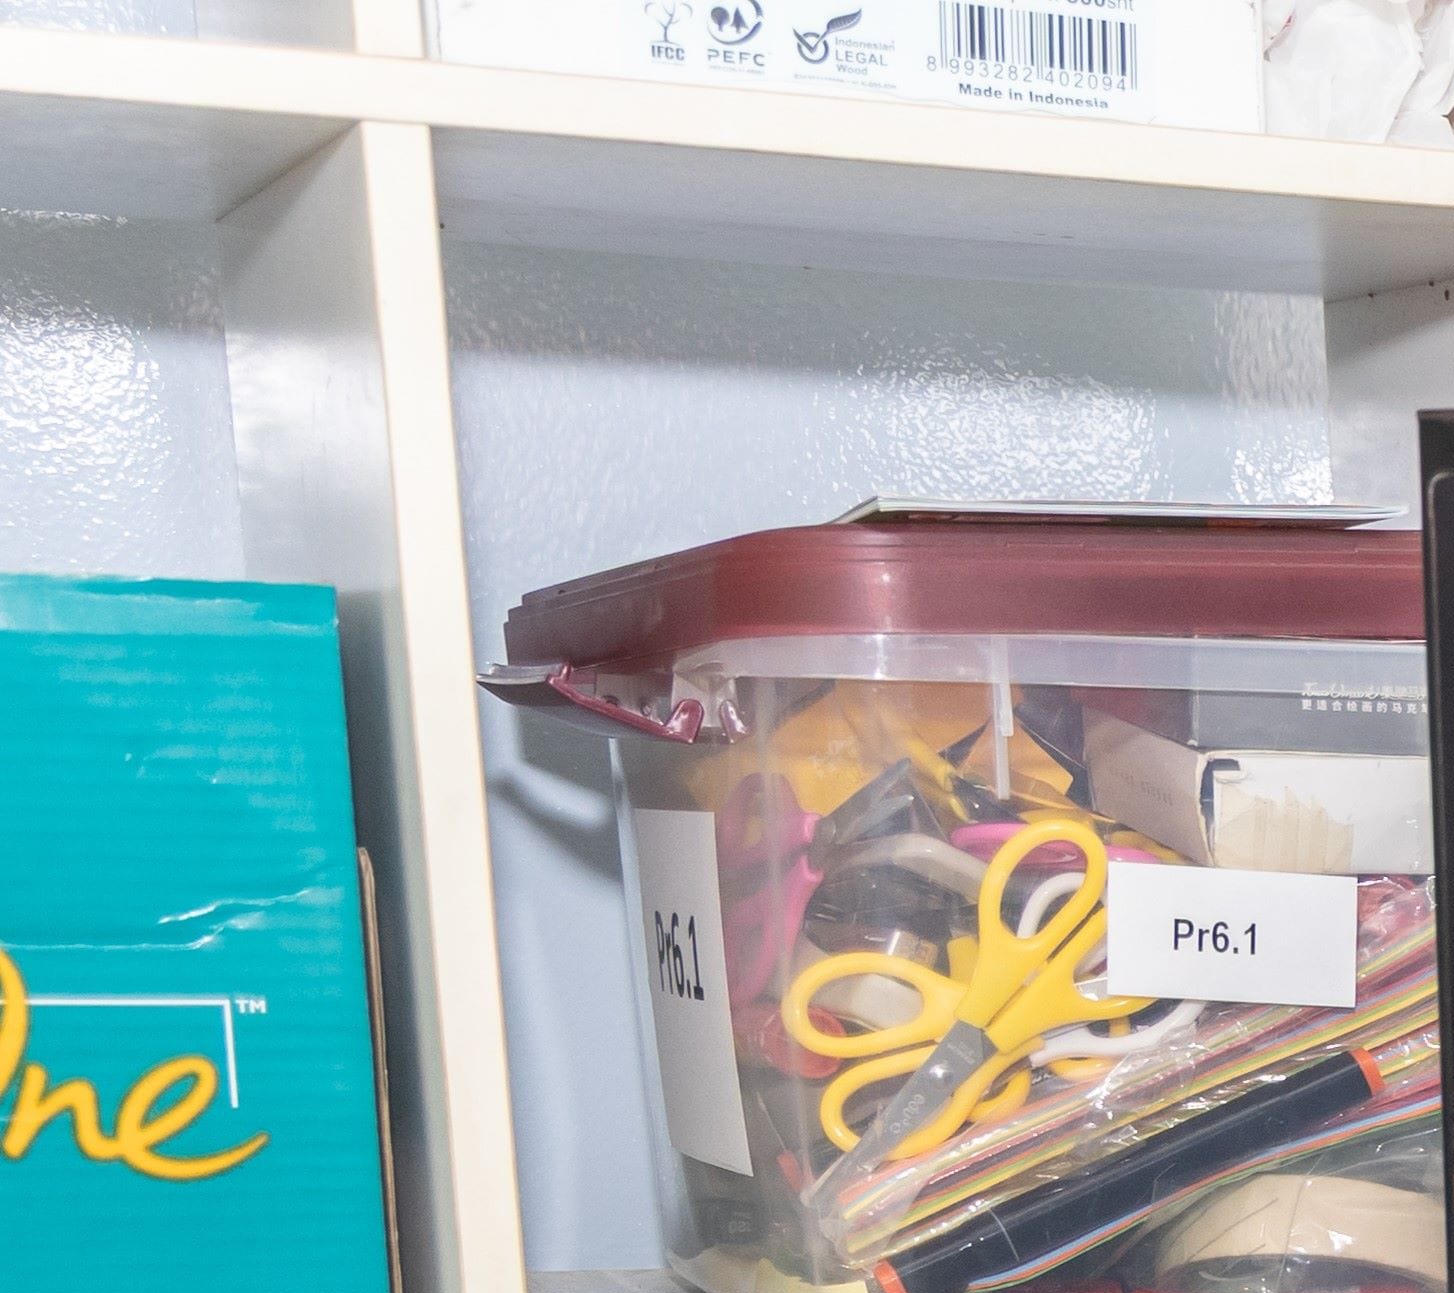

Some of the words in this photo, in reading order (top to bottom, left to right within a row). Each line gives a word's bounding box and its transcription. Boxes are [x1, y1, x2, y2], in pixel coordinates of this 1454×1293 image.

[651, 44, 686, 61] IFCC
[707, 48, 766, 67] PEFC
[835, 51, 888, 67] LEGAL
[836, 64, 868, 76] Wood
[949, 58, 1033, 83] 993282
[1045, 70, 1126, 92] 402094
[958, 83, 1003, 99] Made
[1009, 88, 1023, 101] in
[1030, 91, 1109, 109] Indonesia
[1172, 917, 1259, 956] Pr6.1
[655, 911, 704, 1001] Pr6.1
